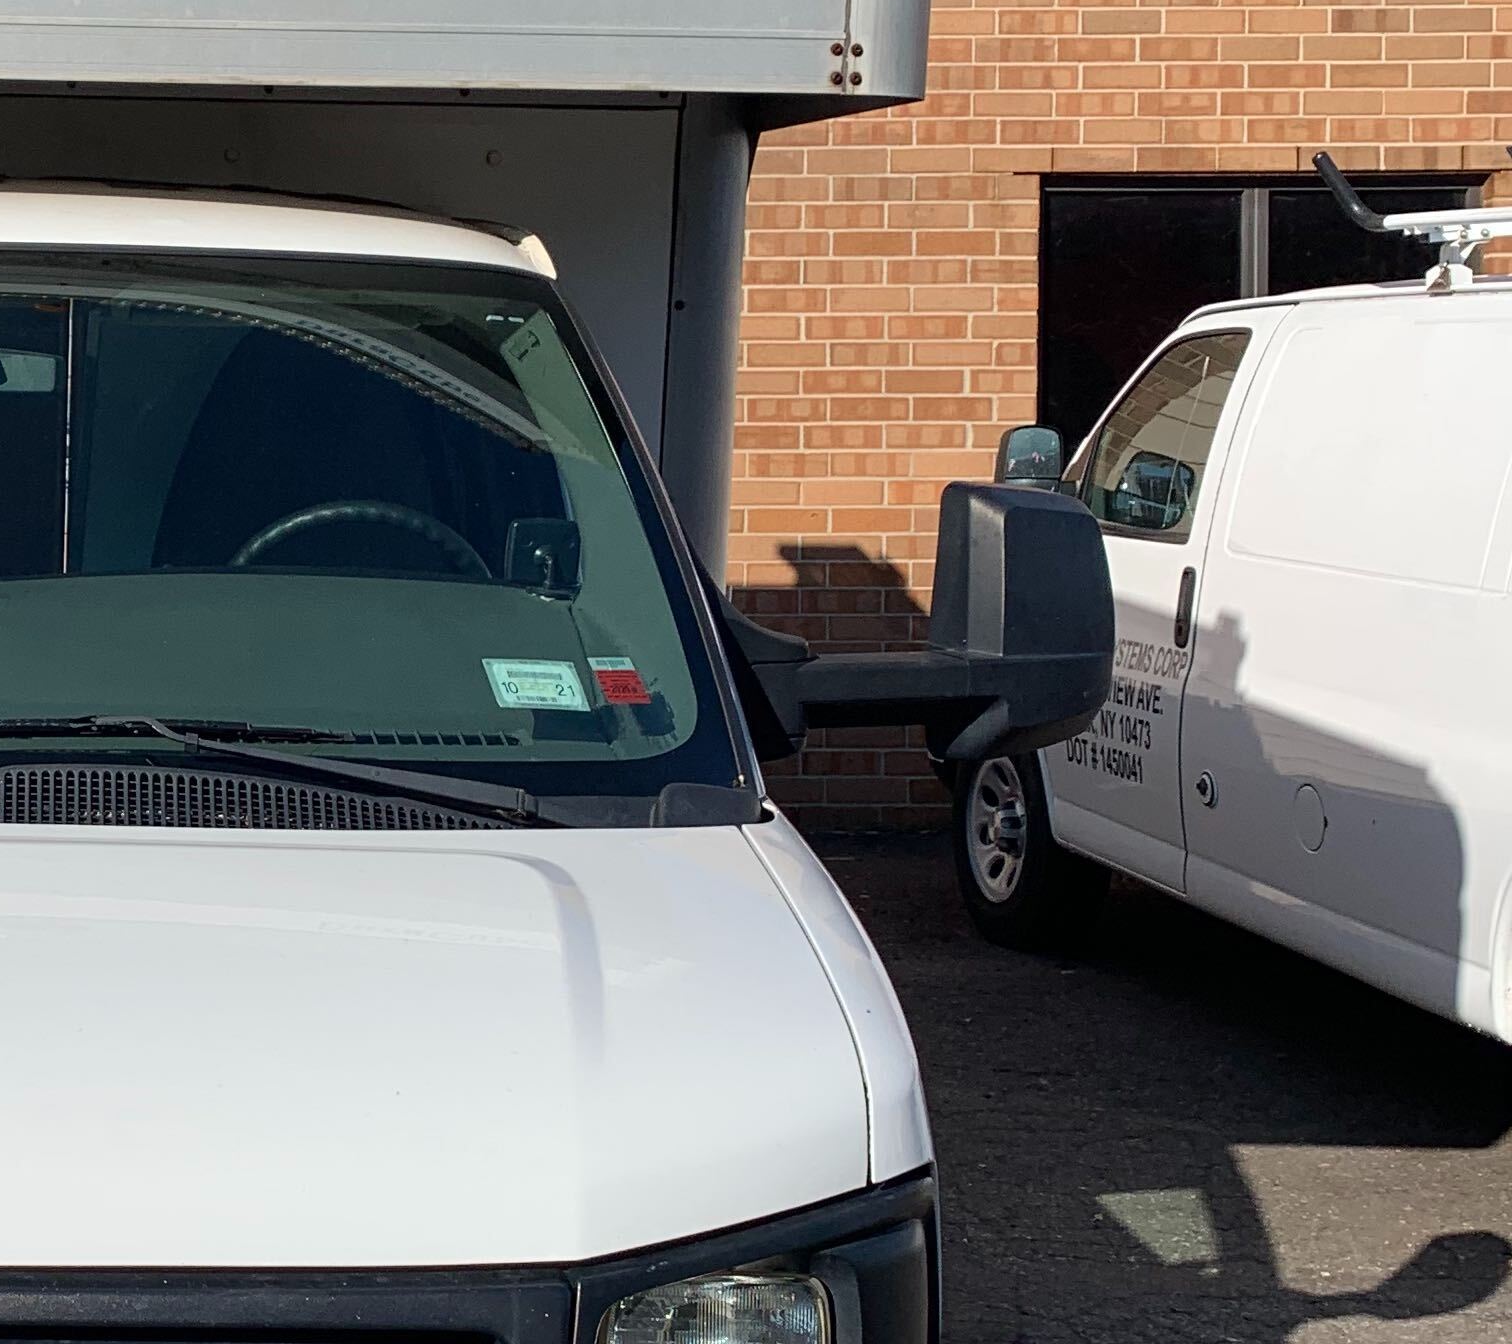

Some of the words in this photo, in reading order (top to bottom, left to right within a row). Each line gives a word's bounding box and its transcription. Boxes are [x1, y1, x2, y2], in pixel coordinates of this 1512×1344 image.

[1115, 638, 1155, 673] STEMS
[1153, 646, 1189, 681] CORP
[501, 681, 519, 694] 10
[555, 683, 576, 697] 21
[1136, 681, 1164, 715] AVE.
[1100, 709, 1116, 739] NY
[1120, 714, 1151, 750] 10473
[1066, 737, 1088, 767] DOT
